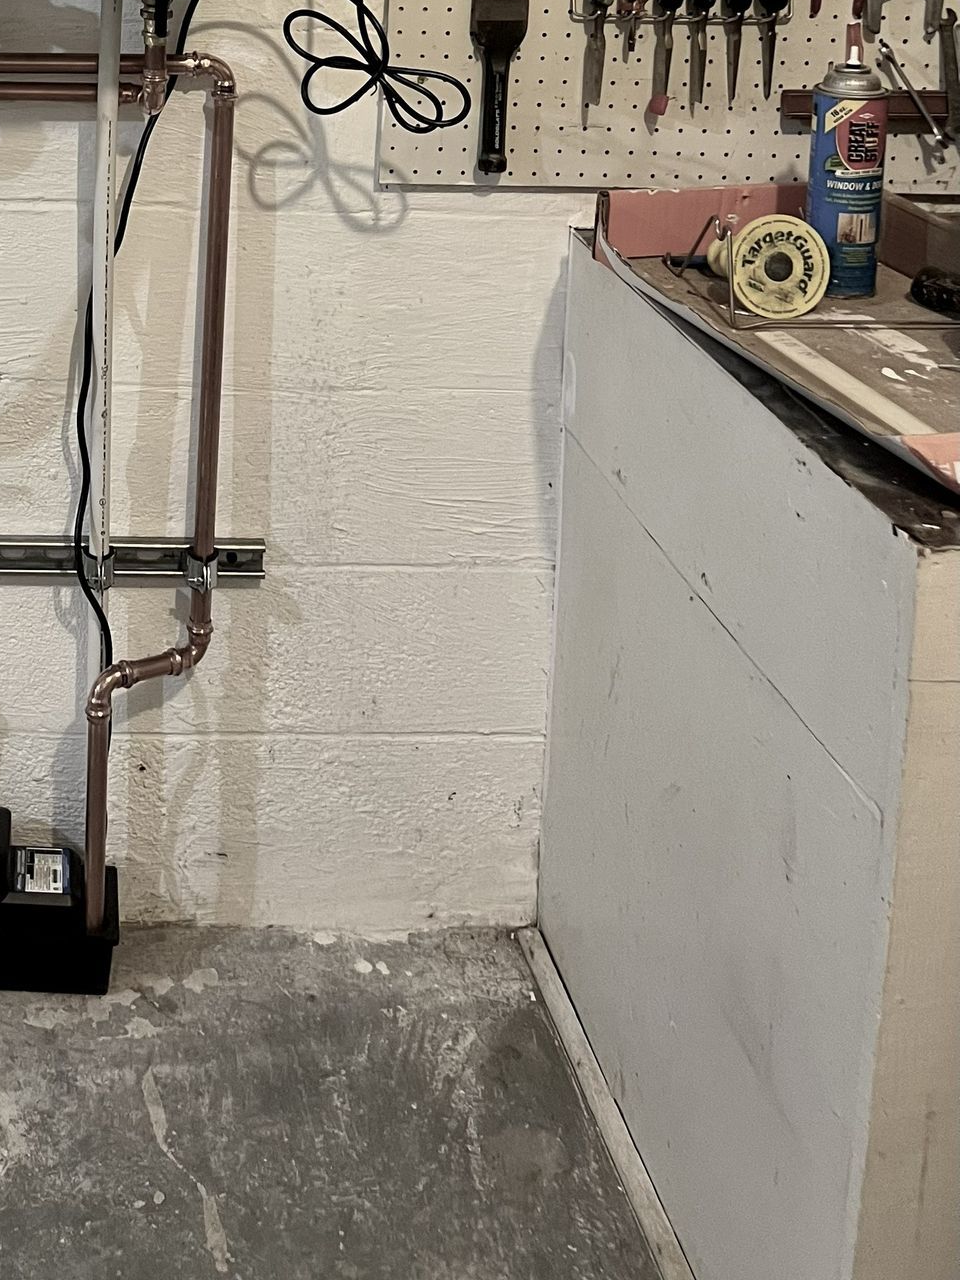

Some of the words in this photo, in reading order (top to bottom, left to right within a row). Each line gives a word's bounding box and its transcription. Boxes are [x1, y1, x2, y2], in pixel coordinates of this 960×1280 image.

[847, 120, 866, 162] GREAT
[864, 121, 880, 162] STUFF
[826, 180, 864, 190] WINDOW
